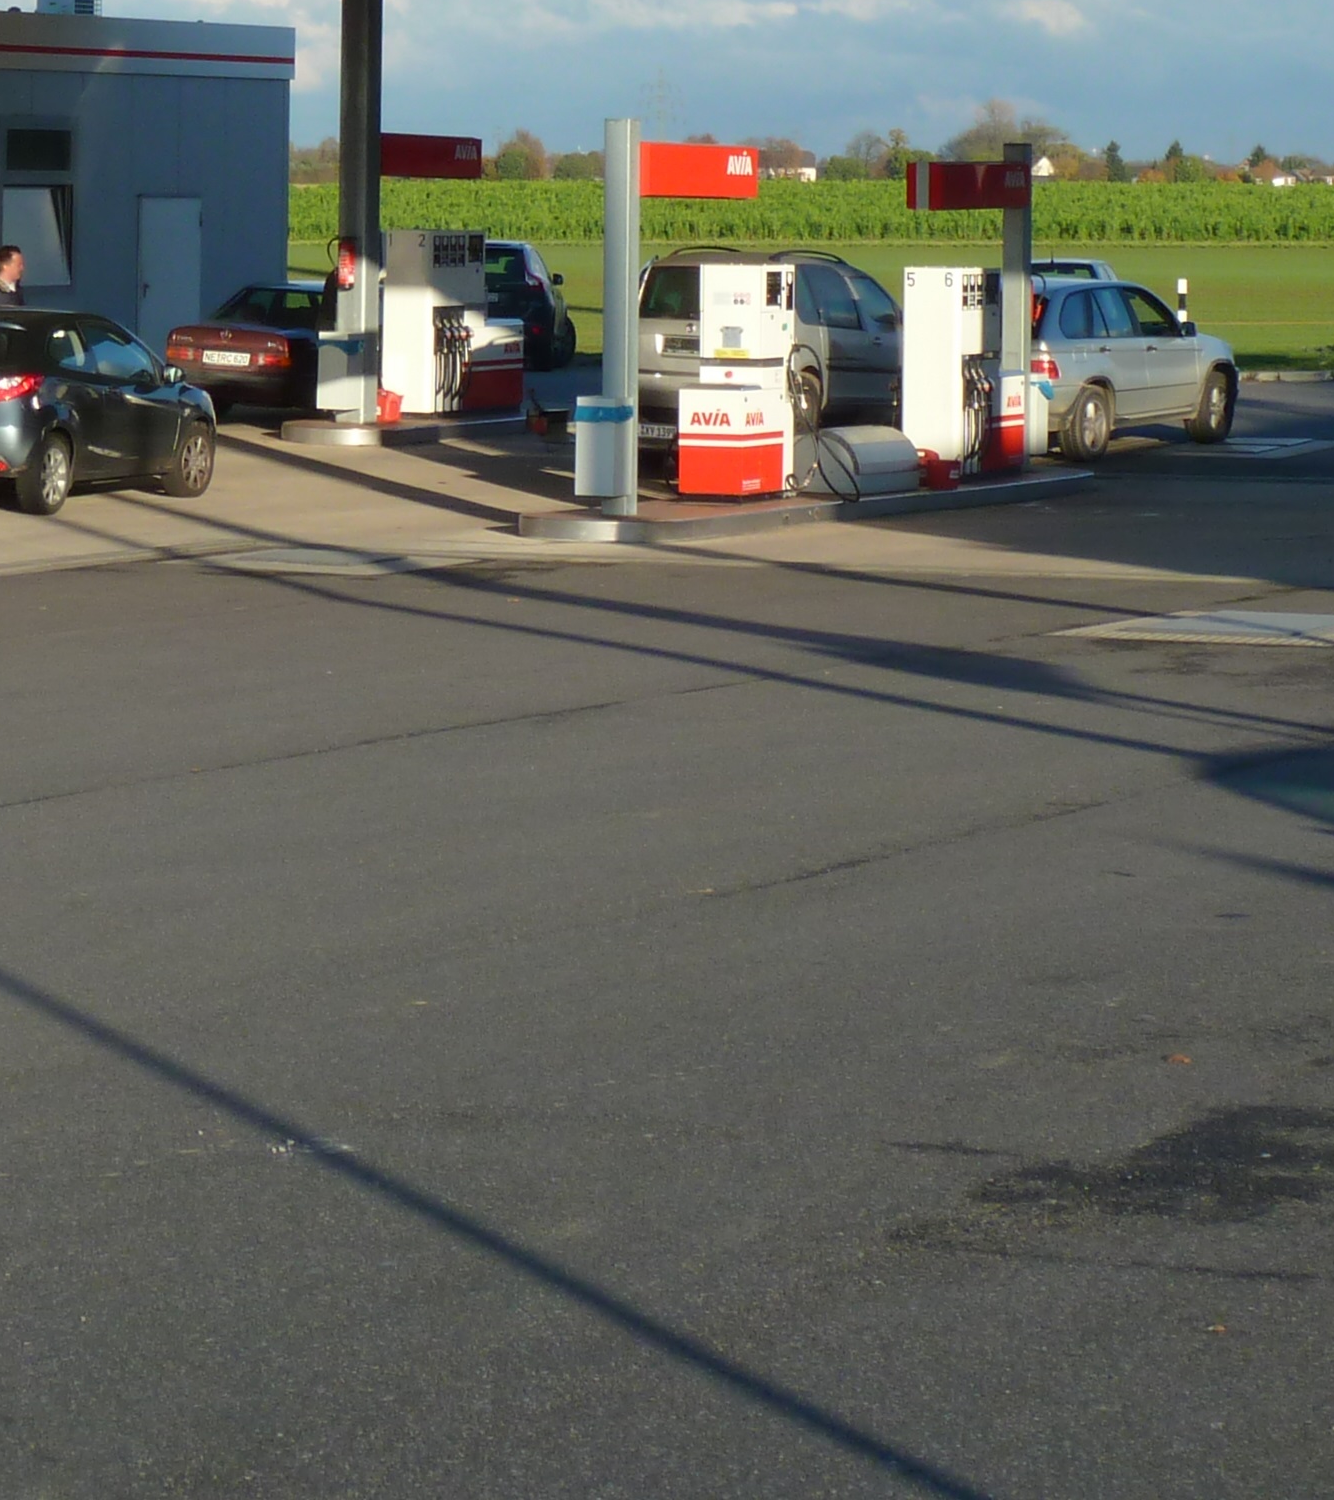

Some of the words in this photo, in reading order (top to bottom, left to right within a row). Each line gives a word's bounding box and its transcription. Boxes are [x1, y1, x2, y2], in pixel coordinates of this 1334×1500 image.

[454, 141, 478, 160] AVIA
[727, 150, 753, 176] AVIA
[418, 233, 426, 247] 2
[907, 272, 916, 287] 5
[944, 272, 953, 287] 6
[690, 408, 732, 427] AVIA
[745, 408, 765, 427] AVIA
